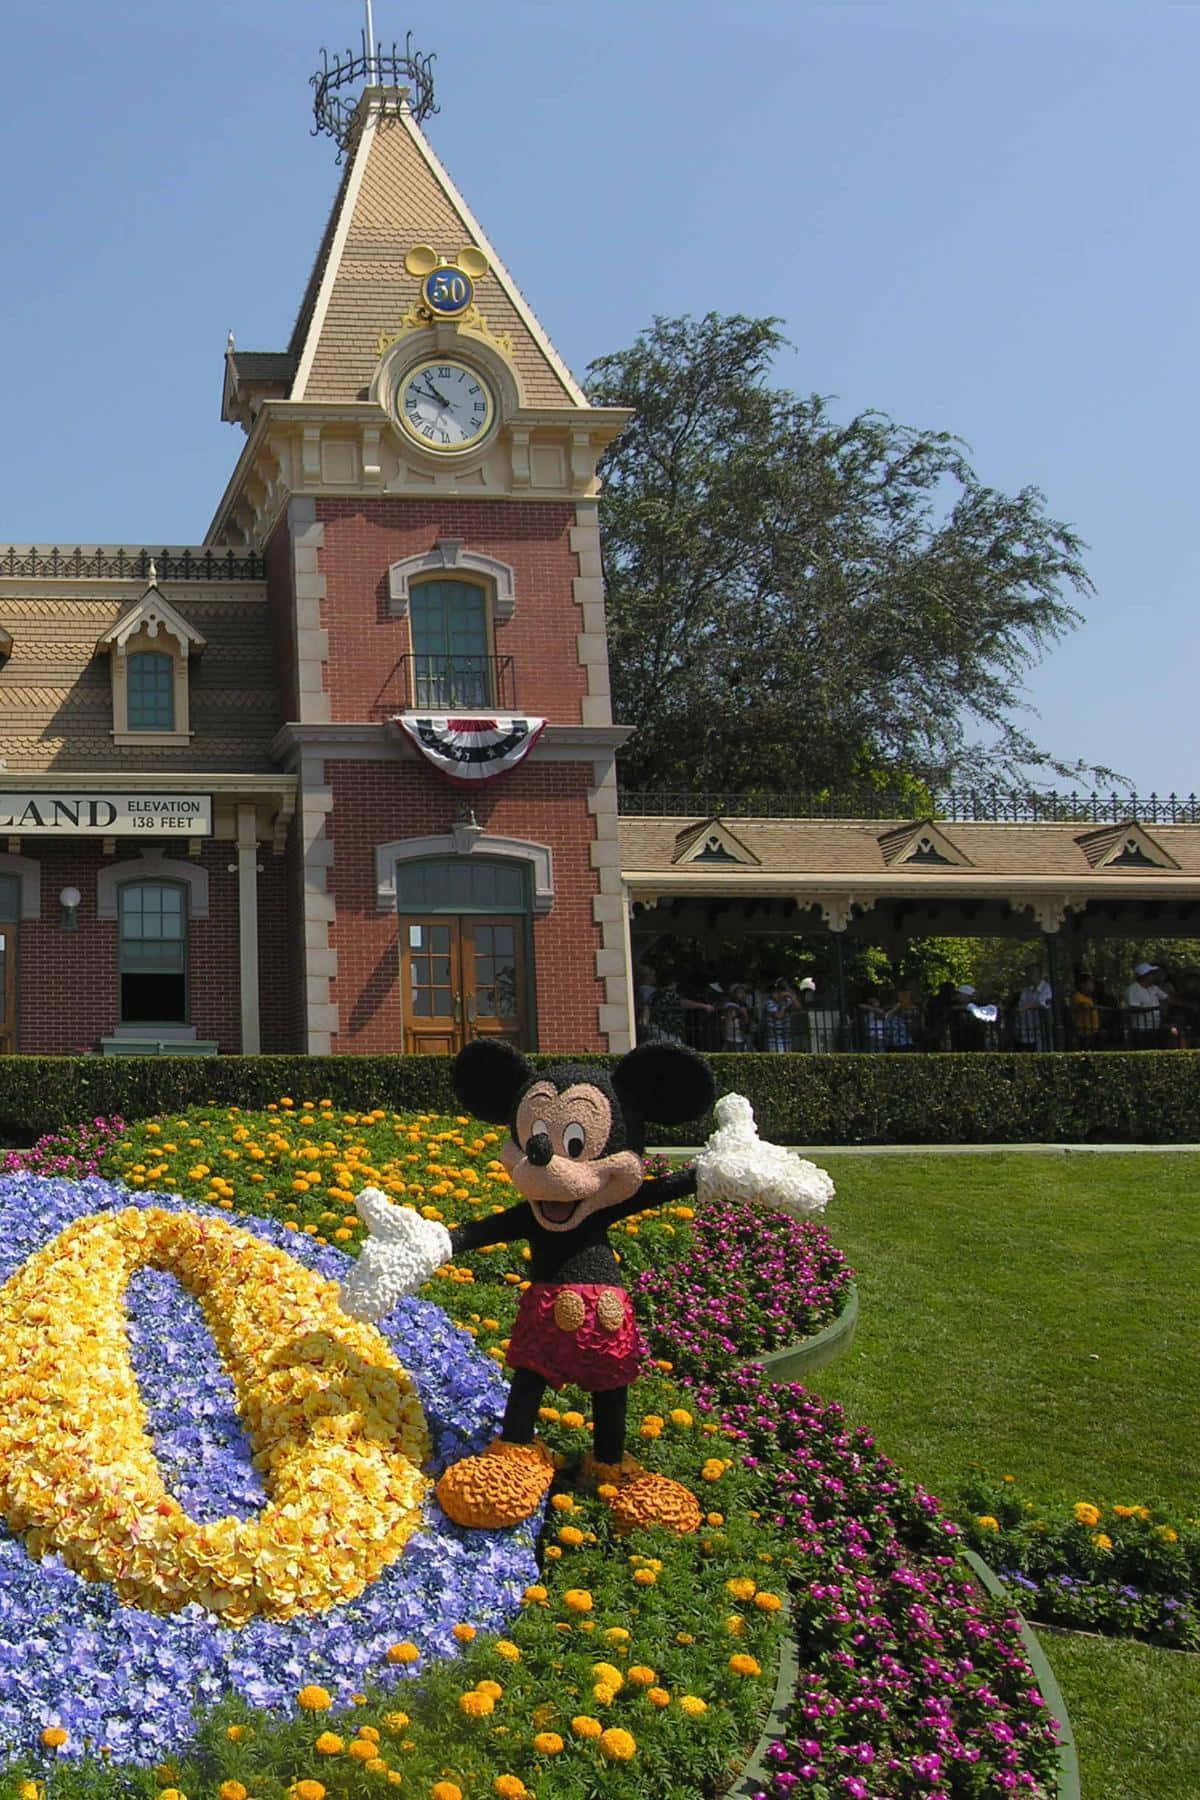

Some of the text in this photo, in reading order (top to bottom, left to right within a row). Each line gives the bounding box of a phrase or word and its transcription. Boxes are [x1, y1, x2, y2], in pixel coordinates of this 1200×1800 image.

[432, 276, 465, 303] 50
[127, 801, 200, 813] ELEVATION
[132, 816, 194, 828] 138 FEET
